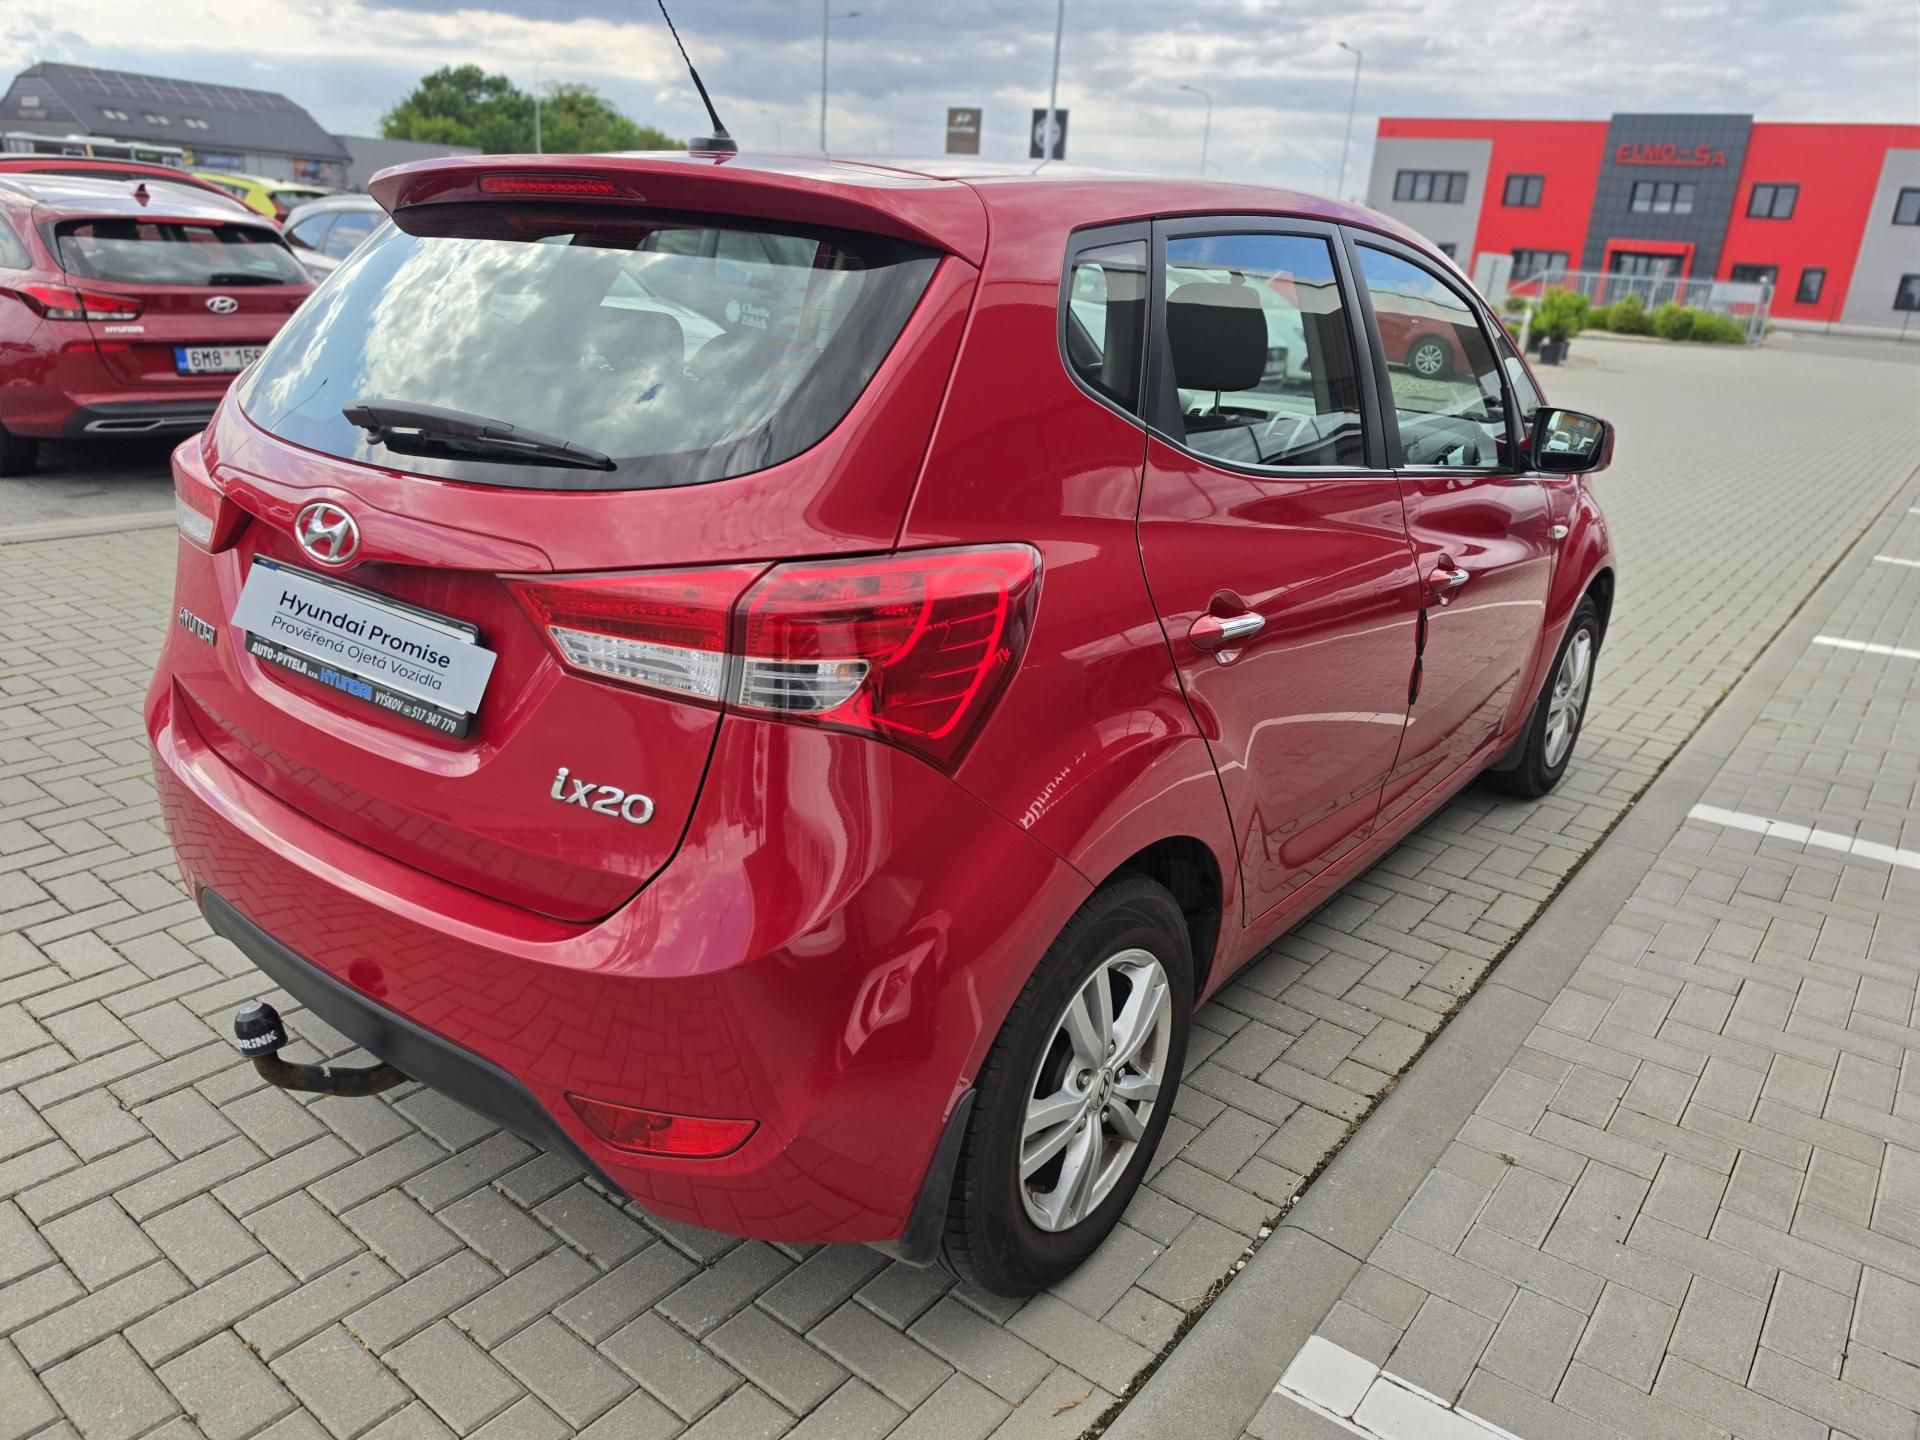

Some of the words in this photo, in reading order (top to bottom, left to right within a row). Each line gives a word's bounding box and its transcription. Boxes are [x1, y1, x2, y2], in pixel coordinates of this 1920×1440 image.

[191, 349, 222, 367] 6M8
[178, 606, 215, 647] HYUNDAI
[271, 615, 345, 653] Prověřená
[348, 645, 387, 670] Ojetá
[391, 660, 442, 690] Vozidla
[279, 591, 367, 637] Hyundai
[369, 625, 450, 668] Promise
[319, 666, 373, 701] HYUNDAI
[374, 691, 404, 712] VYŠKOV
[410, 705, 426, 721] 517
[425, 712, 441, 728] 347
[440, 718, 457, 734] 779
[550, 766, 654, 825] ix20
